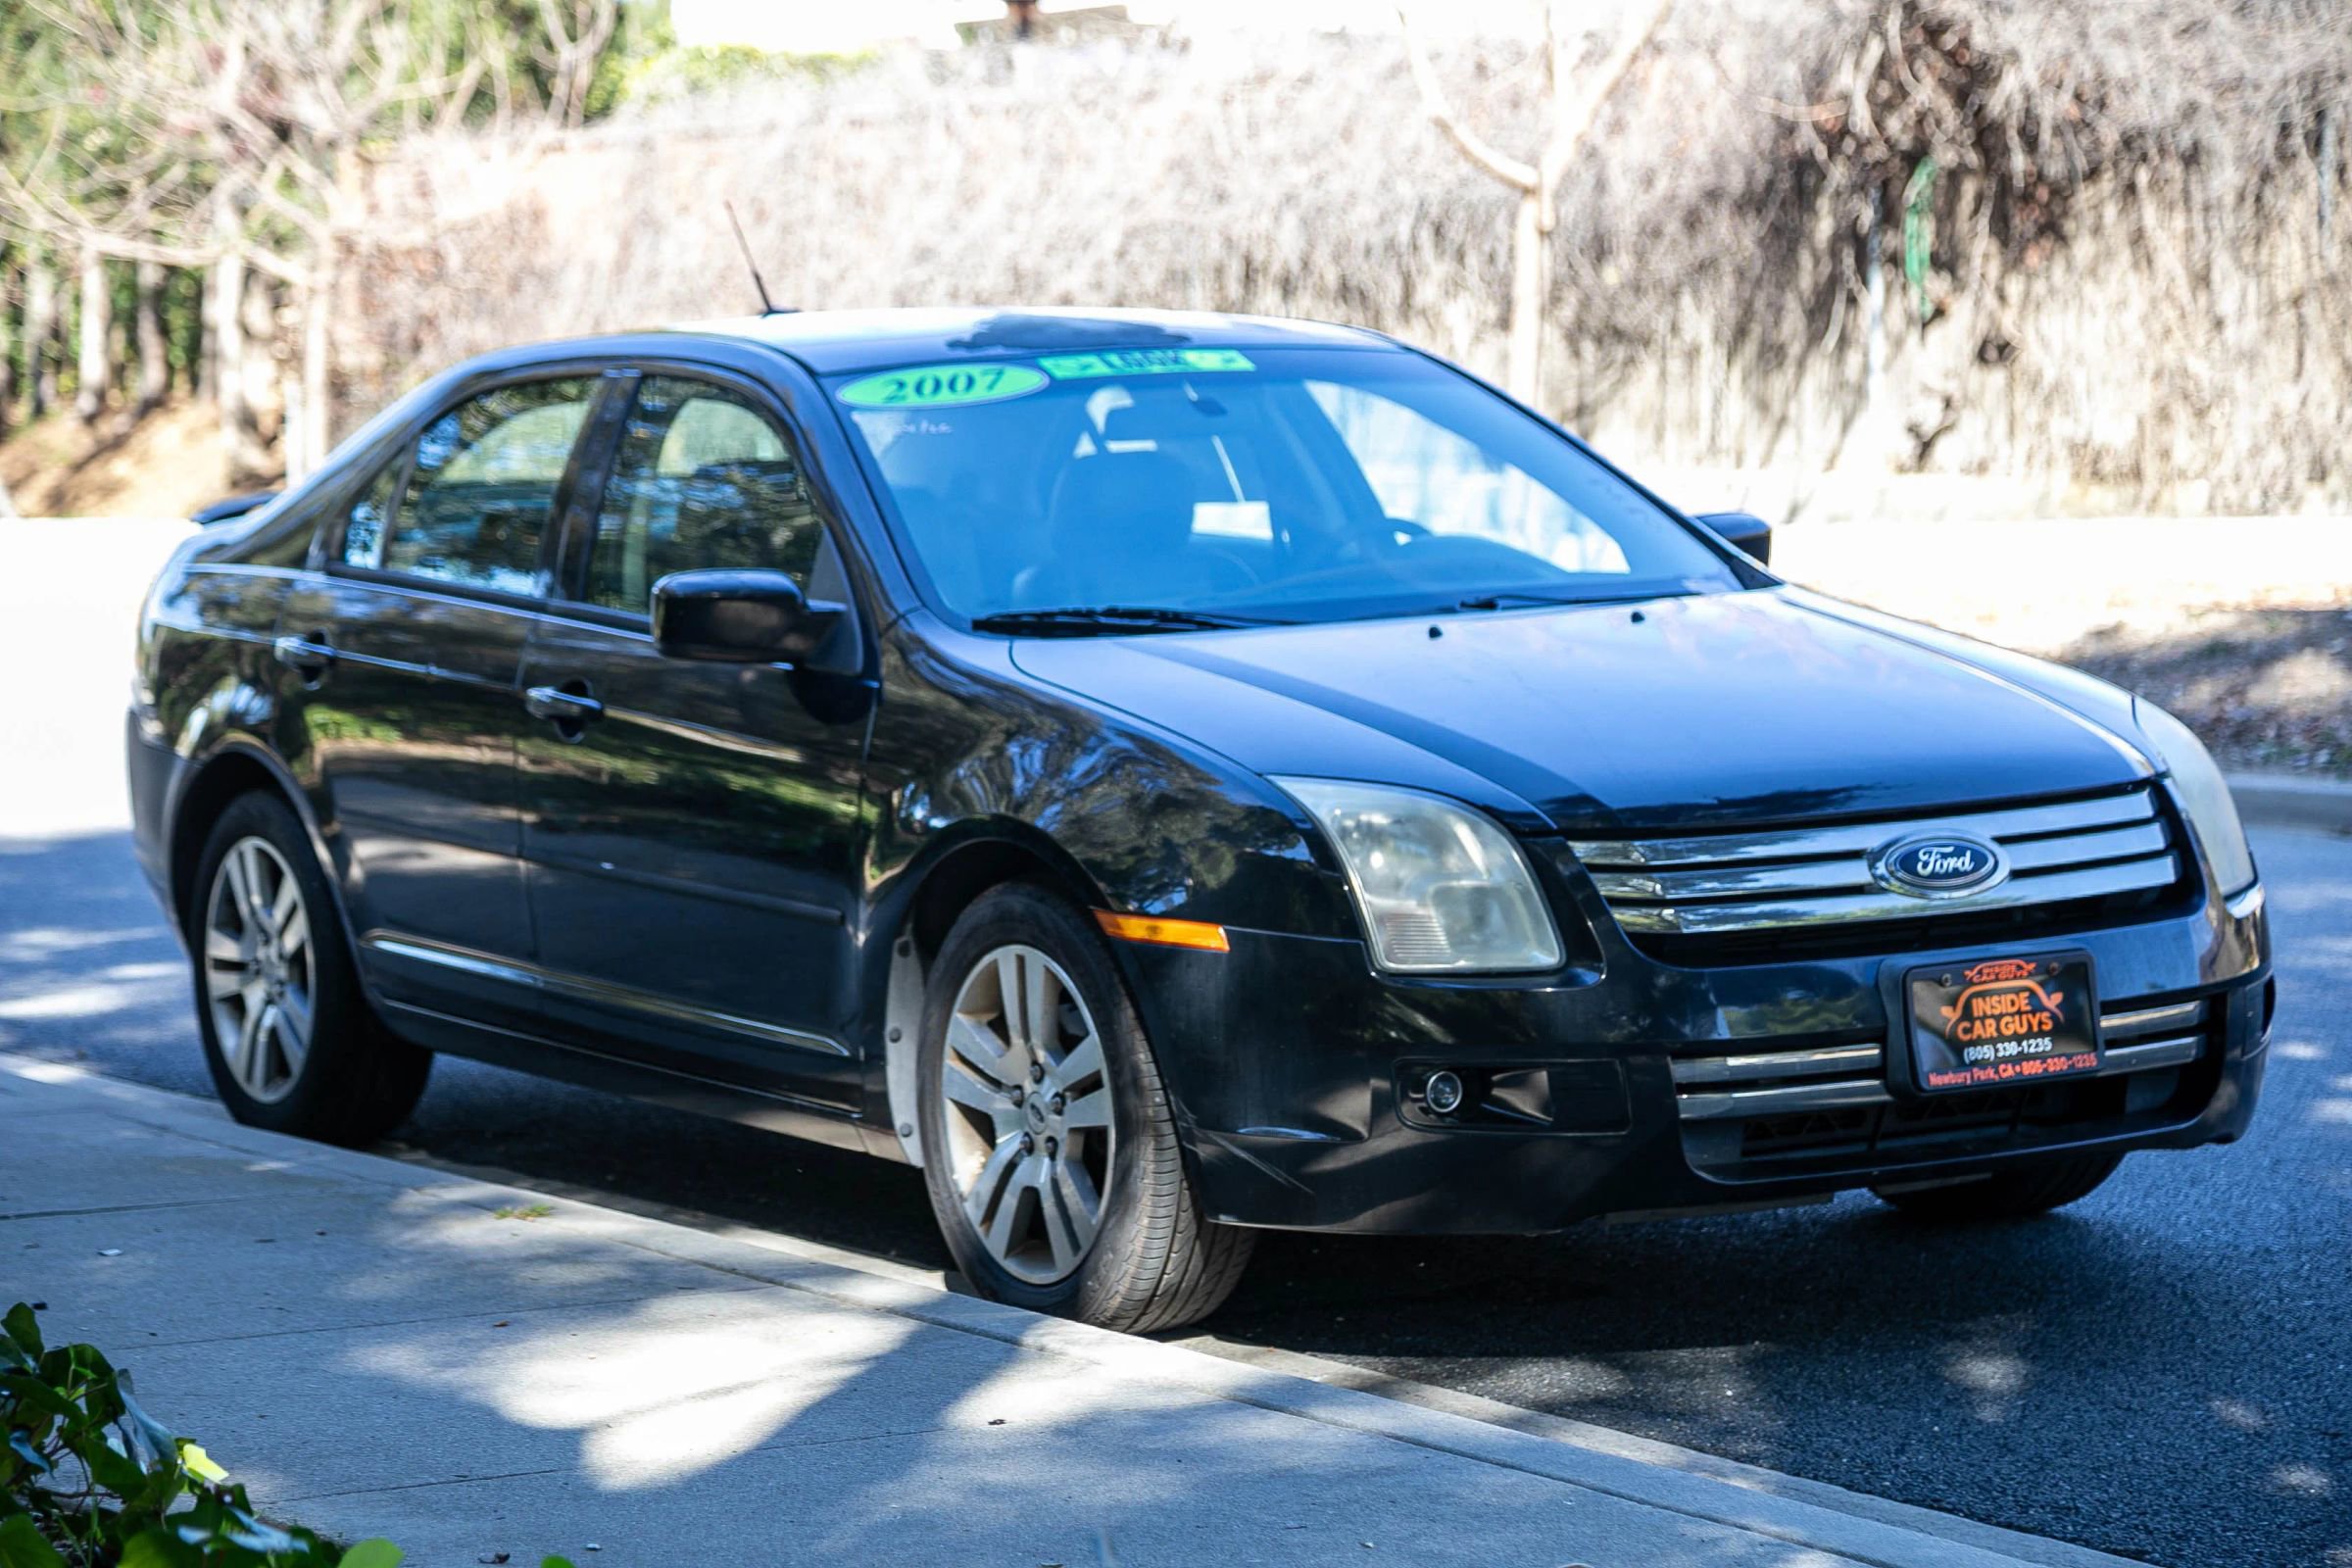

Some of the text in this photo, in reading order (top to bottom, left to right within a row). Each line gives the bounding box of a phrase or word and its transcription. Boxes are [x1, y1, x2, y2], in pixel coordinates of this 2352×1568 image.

[882, 368, 1005, 404] 2007
[1917, 846, 1975, 877] Ford
[1972, 991, 2032, 1016] INSIDE
[1957, 1011, 2053, 1042] CAR GUYS
[1963, 1037, 2052, 1064] (805) 330-1235
[1929, 1071, 1971, 1087] Newbury
[1973, 1066, 1998, 1082] Park,
[1998, 1062, 2014, 1079] CA
